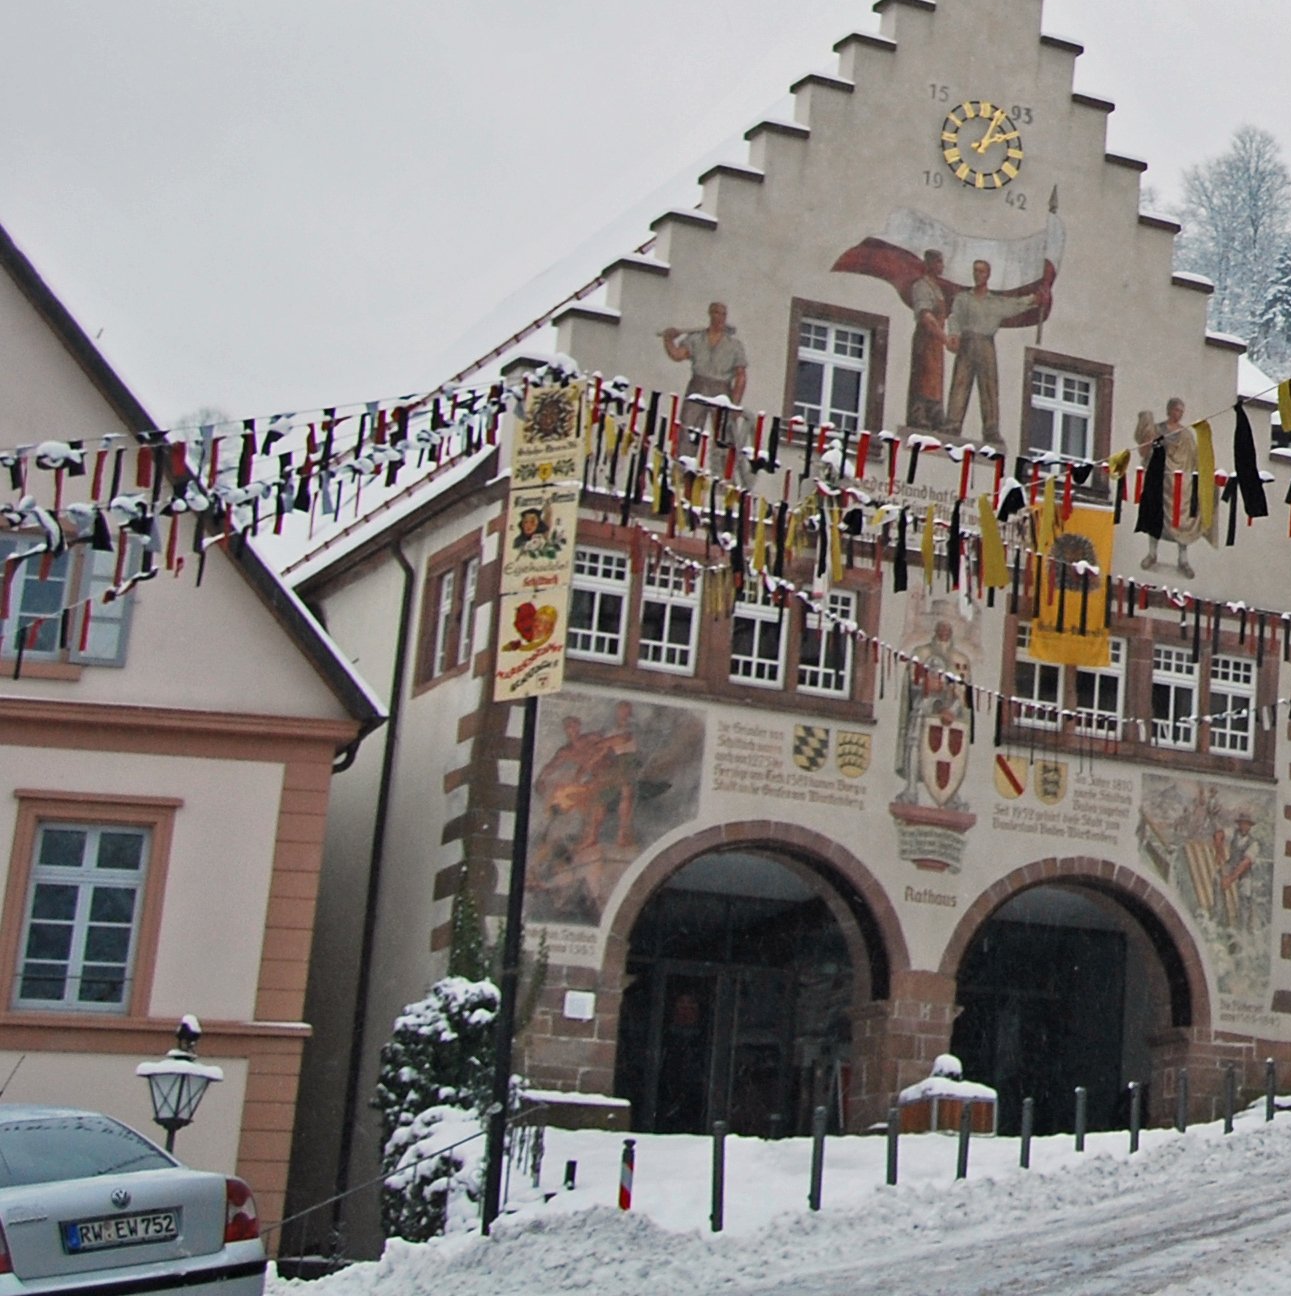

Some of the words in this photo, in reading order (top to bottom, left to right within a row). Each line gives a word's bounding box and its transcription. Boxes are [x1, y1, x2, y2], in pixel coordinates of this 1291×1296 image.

[929, 83, 949, 102] 15
[1010, 105, 1033, 125] 93
[922, 170, 943, 189] 19
[1005, 190, 1027, 210] 42
[904, 885, 958, 908] Rathaus
[79, 1224, 103, 1245] RW
[141, 1214, 176, 1236] 752
